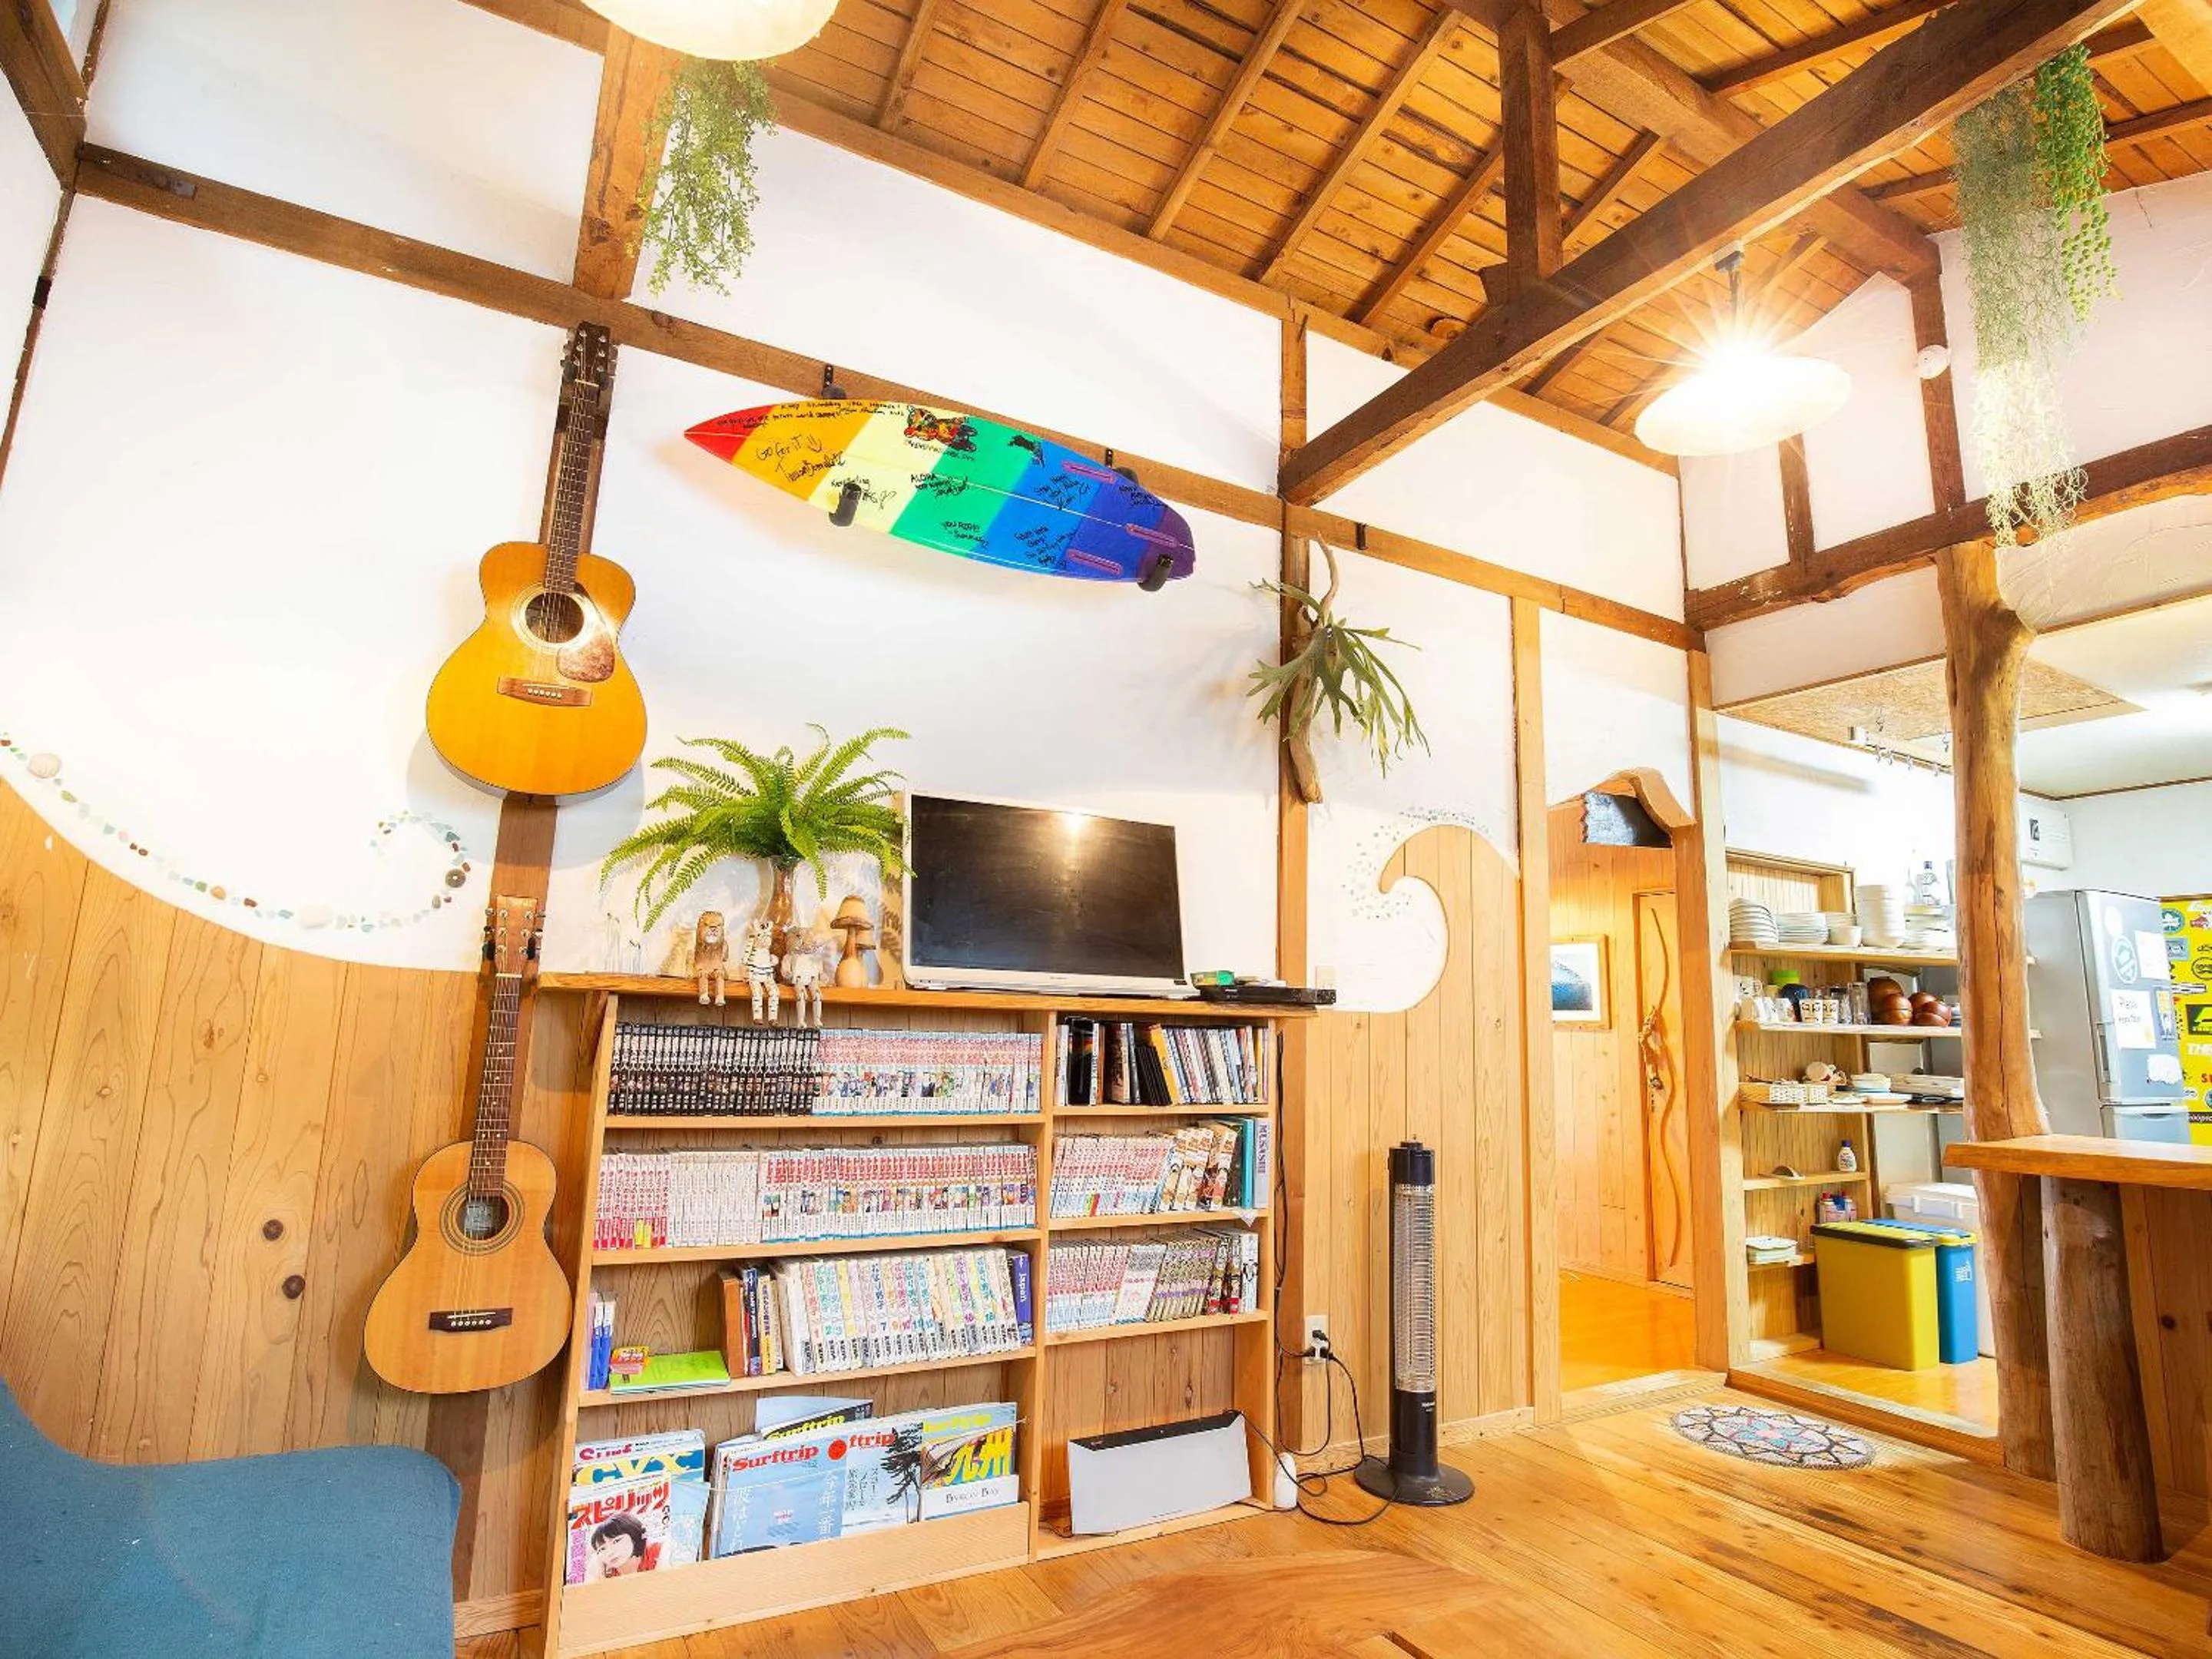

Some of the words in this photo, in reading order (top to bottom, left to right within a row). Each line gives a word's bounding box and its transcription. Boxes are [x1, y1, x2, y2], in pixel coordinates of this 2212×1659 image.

[1018, 1272, 1028, 1303] Japan
[732, 1445, 820, 1472] Surftrip
[943, 1426, 1013, 1485] 九州
[571, 1482, 670, 1530] スピリッツ
